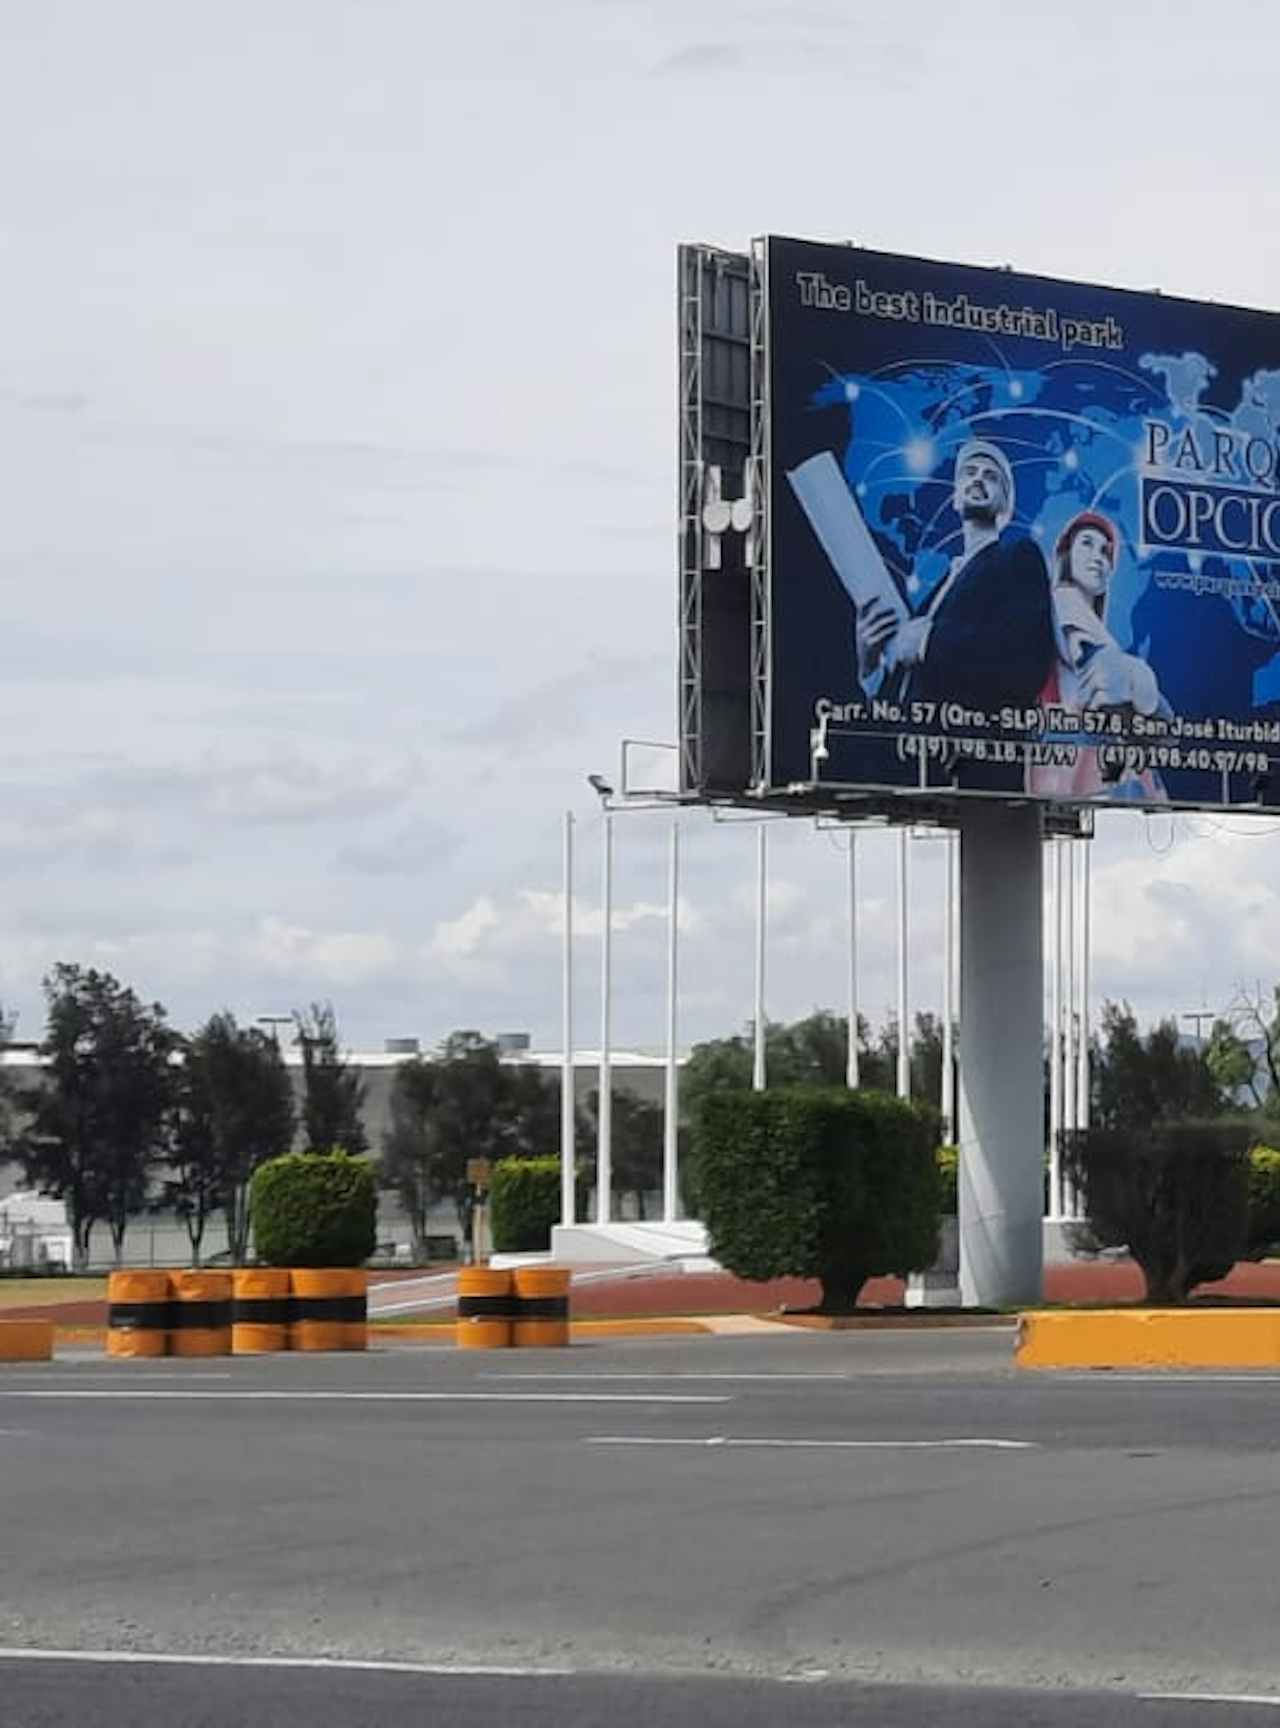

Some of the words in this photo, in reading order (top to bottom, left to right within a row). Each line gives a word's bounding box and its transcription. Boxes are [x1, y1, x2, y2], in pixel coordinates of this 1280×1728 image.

[797, 272, 849, 311] The
[855, 280, 920, 322] best
[923, 292, 1059, 338] industrial
[1061, 315, 1124, 351] park
[815, 699, 868, 722] Carr.
[872, 700, 907, 723] No.
[911, 702, 936, 727] 57
[940, 702, 1045, 733] (Qro.-SLP)
[1049, 706, 1079, 731] Km
[1132, 716, 1168, 737] San
[1171, 716, 1215, 739] José
